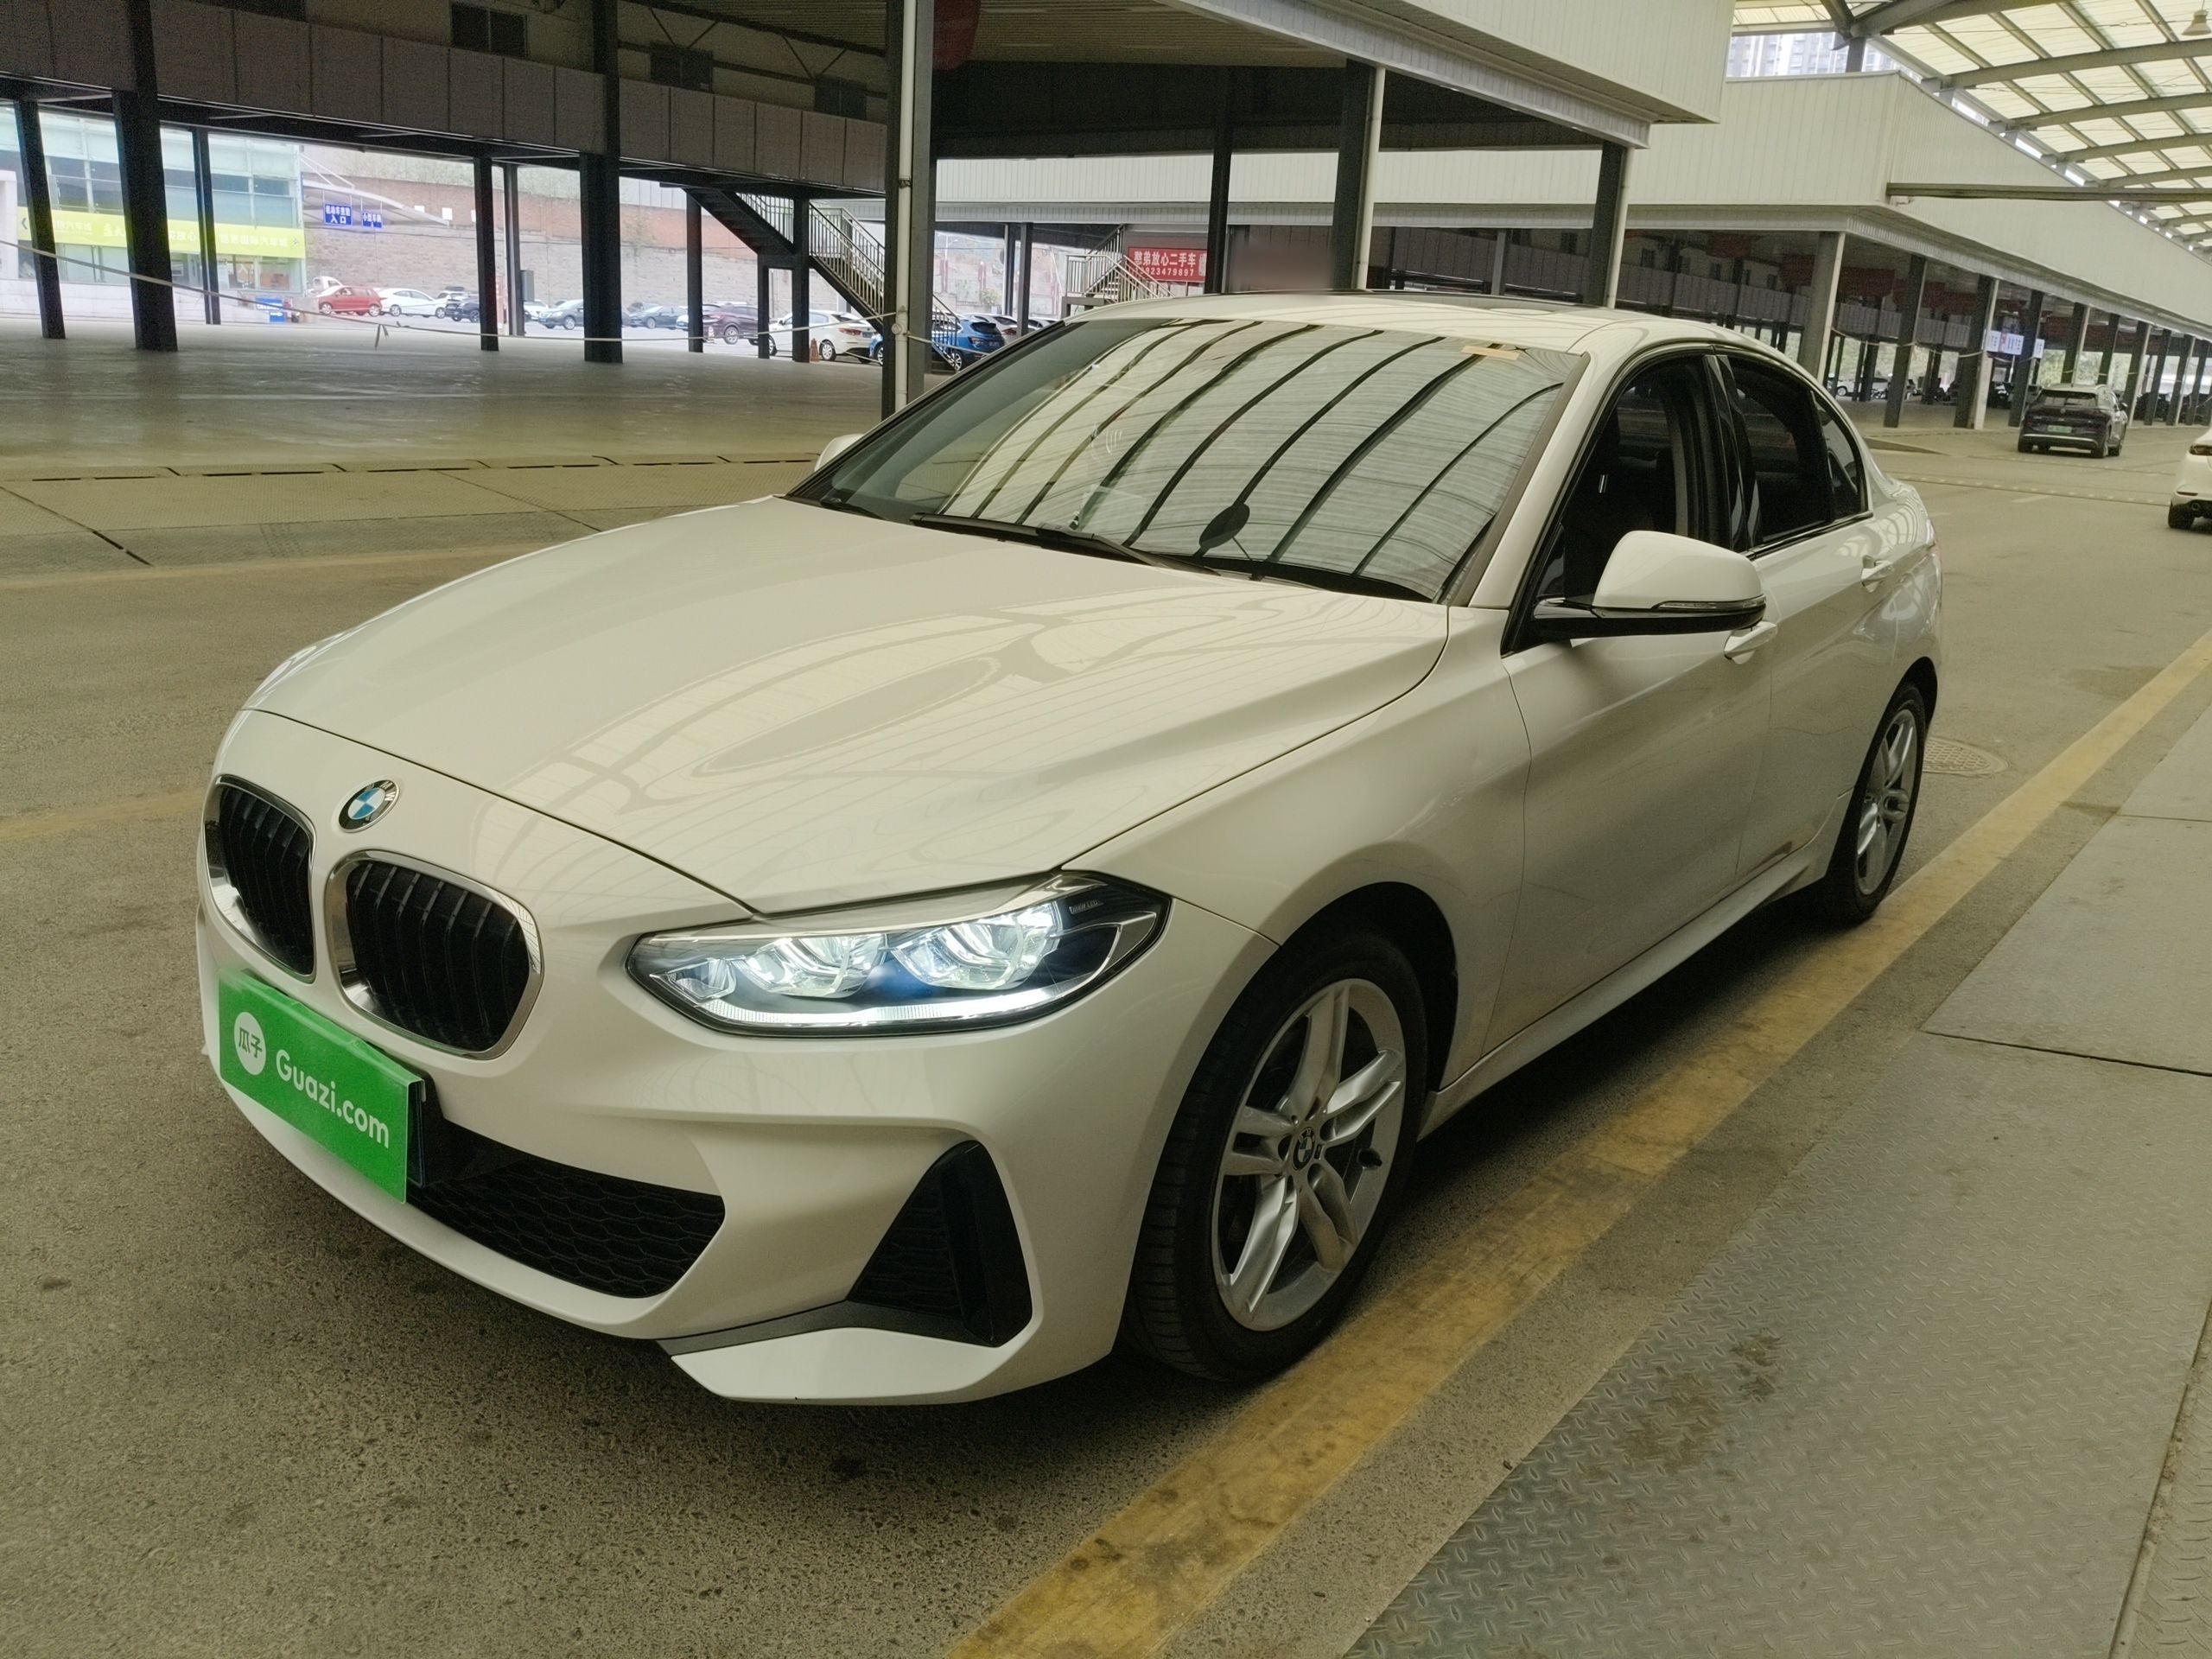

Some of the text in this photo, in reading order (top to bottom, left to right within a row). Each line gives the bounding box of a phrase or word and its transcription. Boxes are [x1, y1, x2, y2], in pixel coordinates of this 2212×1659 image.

[330, 214, 347, 225] 入口
[238, 1027, 264, 1059] 瓜子
[276, 1048, 389, 1149] Guazi.com
